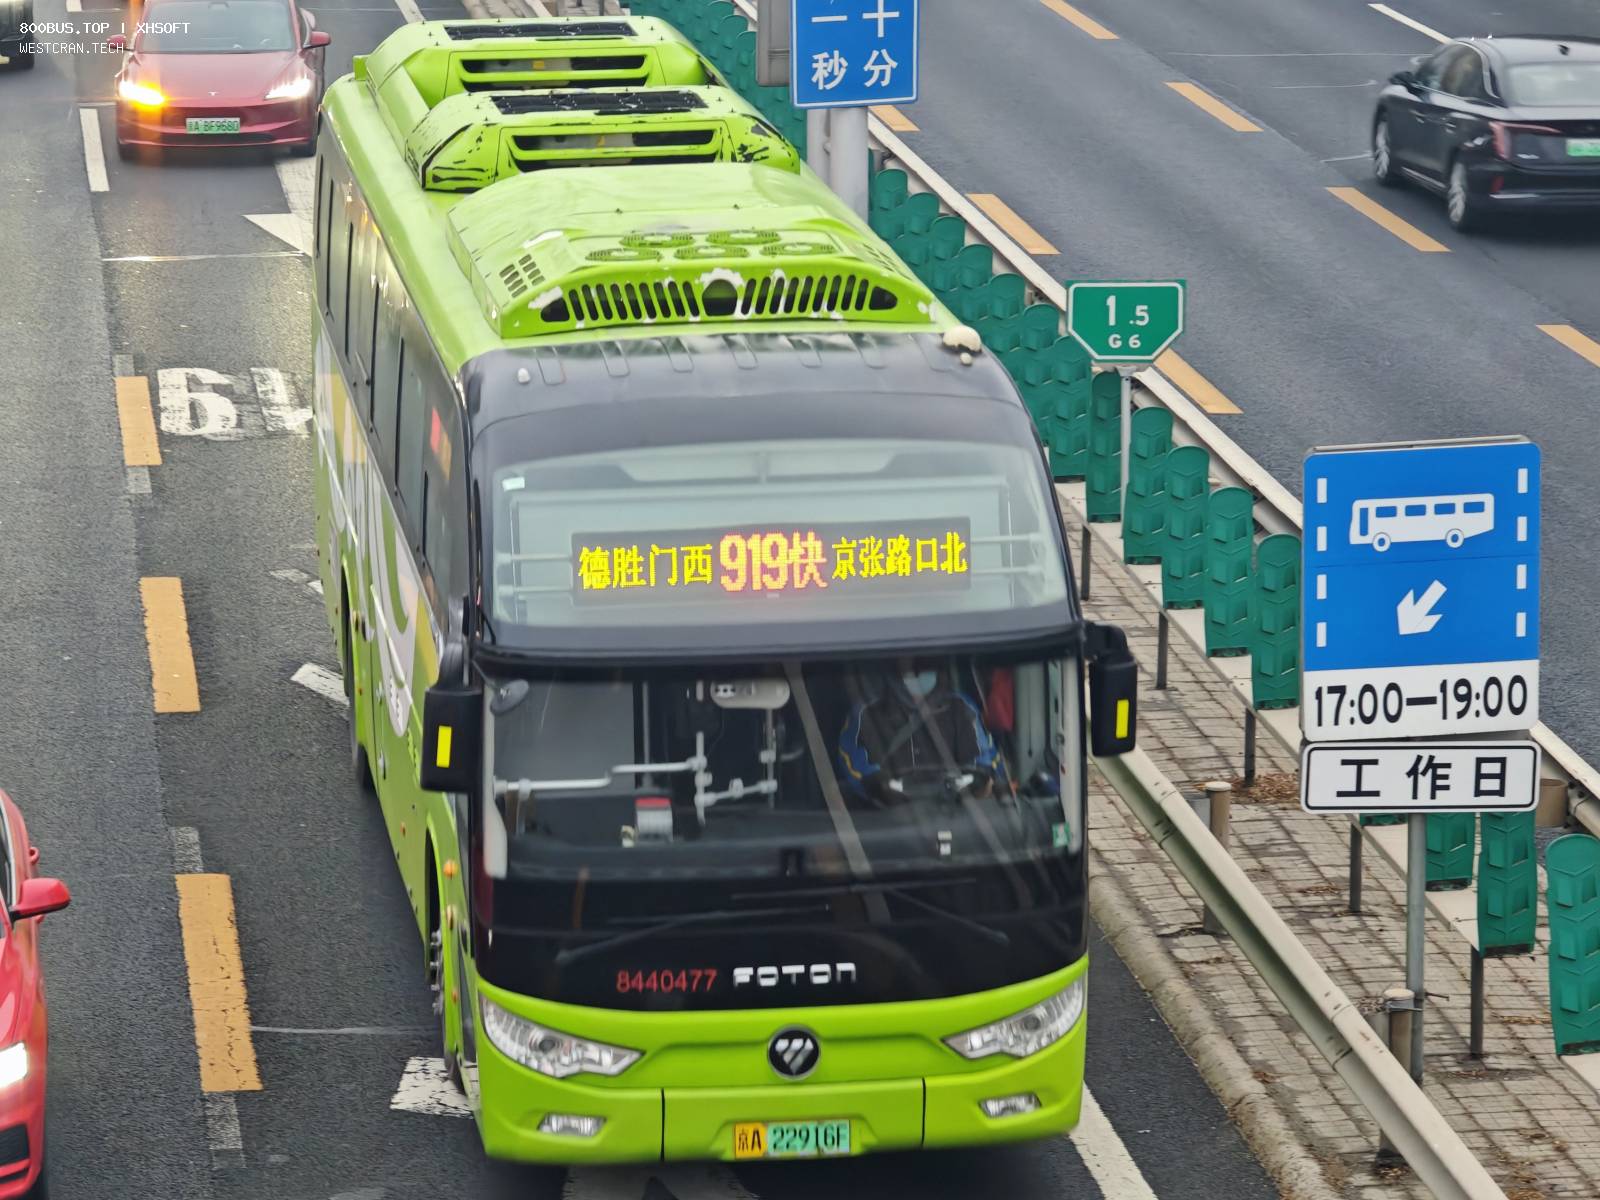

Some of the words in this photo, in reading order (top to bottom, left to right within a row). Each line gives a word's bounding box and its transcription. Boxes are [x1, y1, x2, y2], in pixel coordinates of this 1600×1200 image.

[1108, 333, 1141, 349] G6
[578, 543, 713, 590] 德胜门西
[719, 530, 828, 592] 919快
[831, 531, 968, 580] 京张路口北
[1336, 754, 1507, 800] 工作日
[616, 968, 718, 992] 8440477
[733, 962, 856, 988] FOTON
